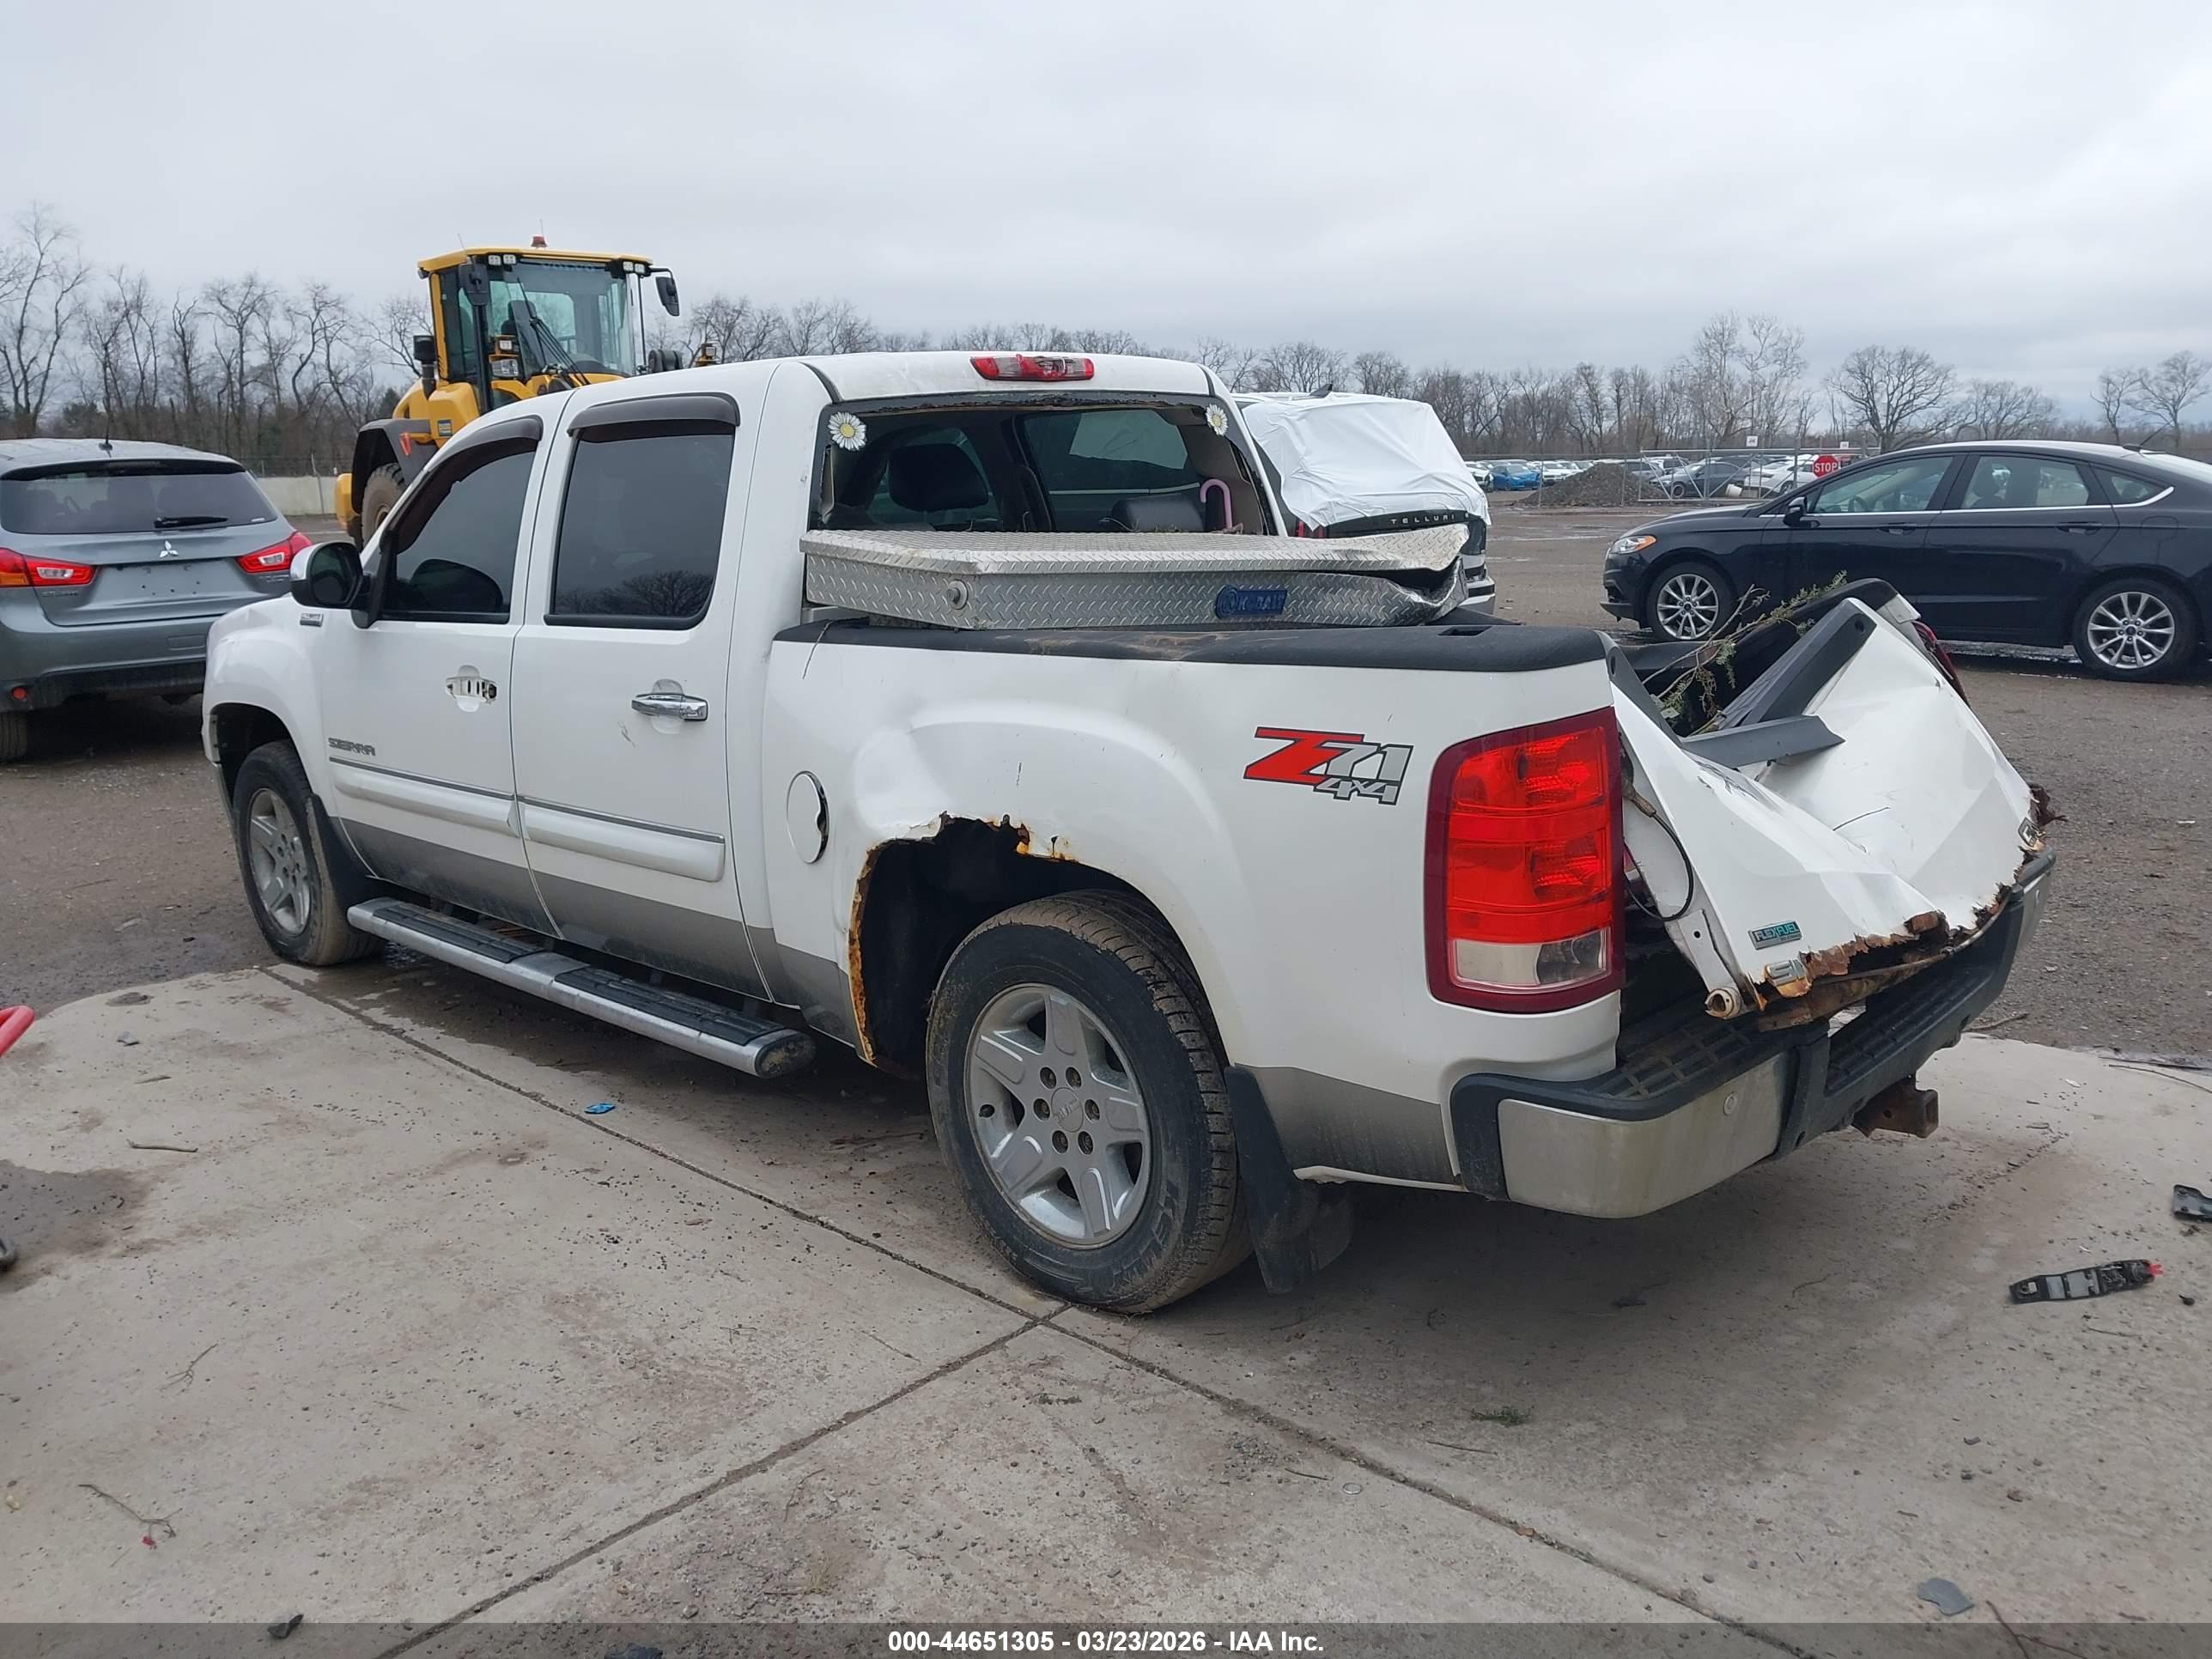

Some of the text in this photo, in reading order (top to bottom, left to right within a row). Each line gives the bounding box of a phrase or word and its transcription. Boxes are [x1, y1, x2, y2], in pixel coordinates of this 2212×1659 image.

[1814, 462, 1838, 473] STOP
[328, 738, 375, 756] SIERRA
[1243, 726, 1413, 787] Z71
[1753, 923, 1800, 943] FLEXFUEL
